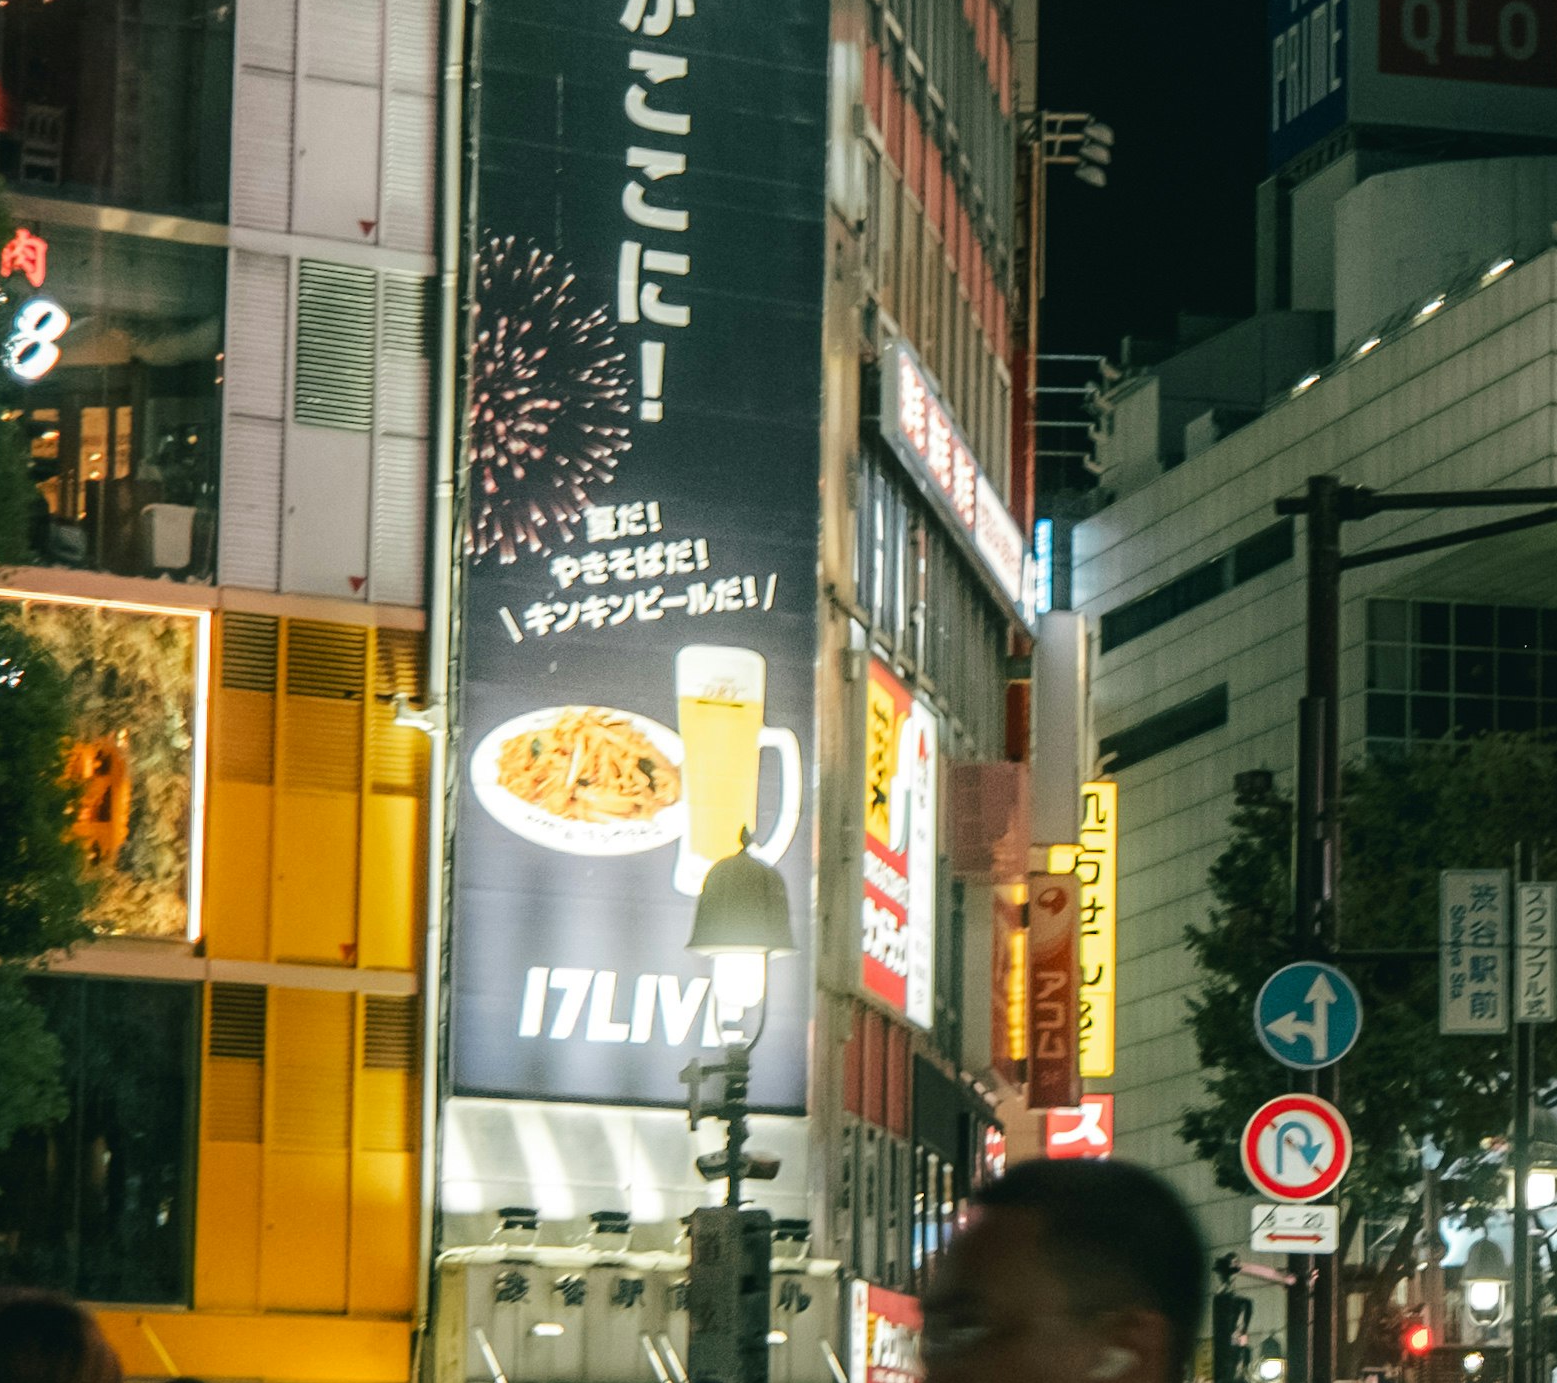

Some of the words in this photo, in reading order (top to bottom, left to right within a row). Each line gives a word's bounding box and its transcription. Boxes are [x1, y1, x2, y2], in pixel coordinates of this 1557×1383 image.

[585, 502, 662, 542] 夏だ!
[550, 540, 710, 587] やきそばだ!
[522, 577, 760, 637] キンキンビールだ!
[1469, 883, 1499, 1020] 渋谷駅前
